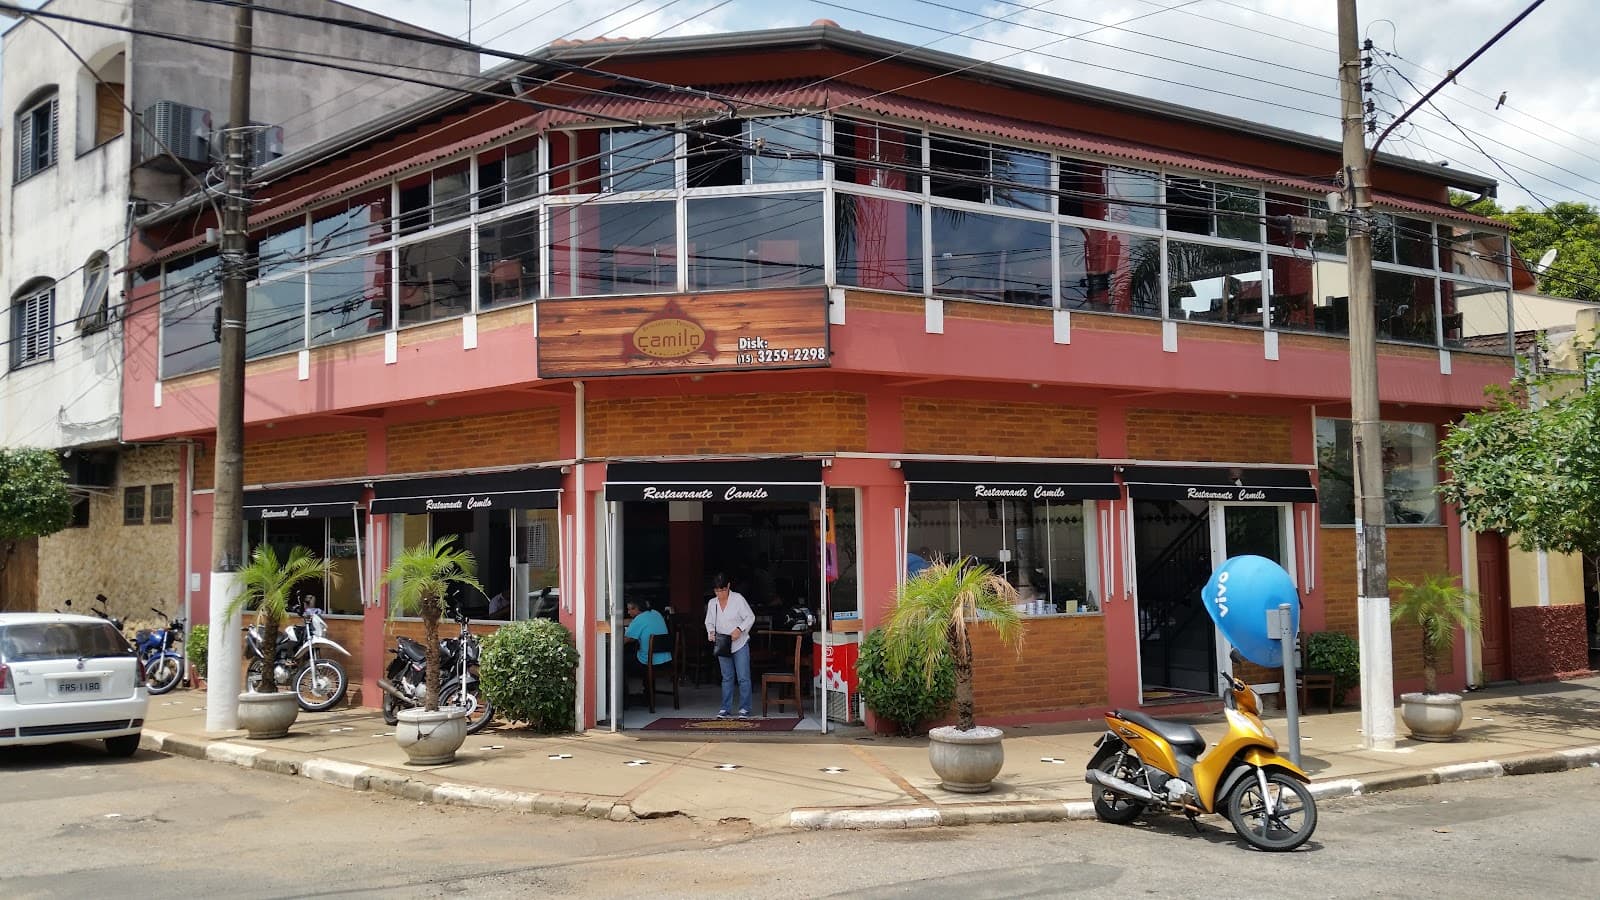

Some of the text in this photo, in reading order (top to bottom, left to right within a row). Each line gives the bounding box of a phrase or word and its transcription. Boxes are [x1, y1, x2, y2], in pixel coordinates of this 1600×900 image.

[638, 328, 700, 348] camilo
[738, 336, 769, 350] Disk:
[736, 347, 826, 365] (15) 3259-2298
[643, 487, 768, 500] Restaurante Camilo
[974, 485, 1066, 499] Restaurante Camilo
[1187, 487, 1266, 501] Restaurante Camilo
[425, 496, 493, 511] Restaurante Camilo
[1215, 571, 1229, 618] vivo
